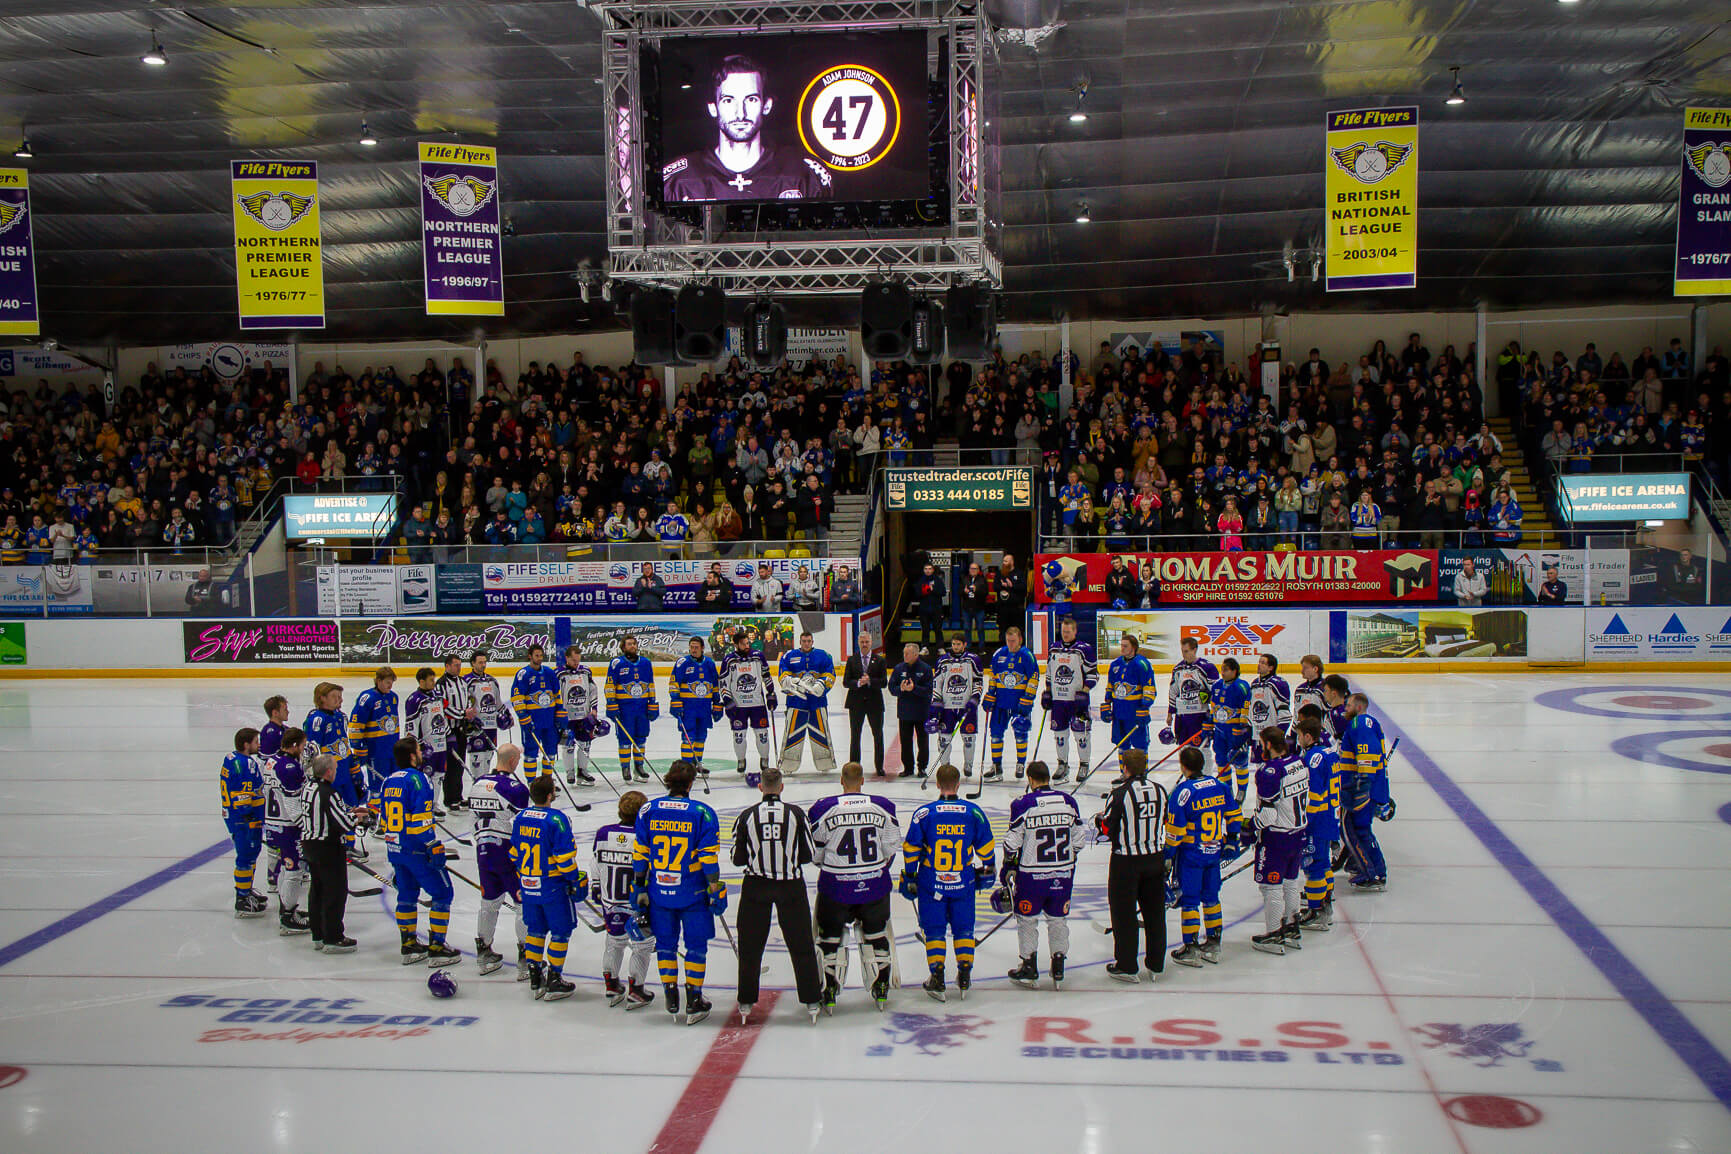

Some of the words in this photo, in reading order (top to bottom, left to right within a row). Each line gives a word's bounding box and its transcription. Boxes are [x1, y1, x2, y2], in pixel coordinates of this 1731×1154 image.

[822, 71, 842, 86] ADAM
[843, 70, 875, 85] JOHNSON
[822, 95, 873, 140] 47
[1334, 113, 1362, 126] Fife
[1363, 111, 1410, 126] Flyers
[1690, 111, 1712, 124] Fife
[427, 146, 452, 158] Fife
[453, 147, 491, 163] Flyers
[830, 154, 847, 166] 1994
[853, 153, 871, 165] 2023
[240, 163, 265, 175] Fife
[266, 163, 311, 178] Flyers
[1337, 189, 1401, 203] BRITISH
[1332, 205, 1411, 220] NATIONAL
[425, 220, 499, 234] NORTHERN
[1340, 222, 1402, 236] LEAGUE
[238, 237, 319, 248] NORTHERN
[433, 236, 493, 249] PREMIER
[246, 252, 312, 263] PREMIER
[437, 252, 491, 264] LEAGUE
[1343, 248, 1397, 260] 2003/04
[250, 267, 310, 278] LEAGUE
[441, 276, 488, 287] 1996/97
[255, 290, 307, 301] 1976/77
[177, 351, 202, 359] CHIPS
[262, 350, 290, 358] PIZZAS
[105, 382, 113, 401] G
[888, 469, 1030, 482] trustedtrader.scot/Fife
[913, 490, 944, 501] 0333
[947, 489, 970, 500] 444
[973, 489, 1004, 500] 0185
[1579, 486, 1607, 497] FIFE
[1612, 486, 1633, 497] ICE
[1637, 484, 1686, 496] ARENA
[314, 497, 358, 509] ADVERTISE
[305, 513, 329, 523] FIFE
[332, 512, 352, 523] ICE
[408, 568, 423, 577] Fife
[507, 564, 538, 575] FIFE
[539, 563, 574, 575] SELF
[664, 562, 700, 573] SELF
[1111, 554, 1258, 583] THOMAS
[1265, 552, 1358, 582] MUIR
[1598, 562, 1626, 570] Trader
[664, 574, 700, 582] DRIVE
[1172, 583, 1223, 591] KIRKCALDY
[1225, 583, 1250, 591] 01592
[1286, 583, 1323, 591] ROSYTH
[1325, 582, 1350, 591] 01383
[1351, 581, 1381, 590] 420000
[485, 594, 508, 602] Tel:
[511, 592, 593, 602] 01592772410
[609, 591, 632, 601] Tel:
[1183, 592, 1203, 601] SKIP
[1205, 592, 1226, 600] HIRE
[1228, 592, 1252, 600] 01592
[1254, 592, 1284, 600] 651076
[266, 624, 337, 635] KIRKCALDY
[1180, 624, 1286, 645] BAY
[190, 624, 264, 662] Styx
[267, 635, 273, 643] &
[276, 635, 336, 643] GLENROTHES
[367, 623, 486, 657] Pettycur
[485, 624, 549, 650] Bay
[1589, 633, 1643, 643] SHEPHERD
[1648, 633, 1700, 643] Hardies
[1204, 647, 1262, 656] HOTEL
[946, 686, 967, 694] CLAN
[1357, 744, 1369, 753] 50
[1140, 802, 1155, 817] 20
[519, 825, 541, 838] HUMITZ
[650, 820, 693, 833] DESROCHER
[763, 824, 781, 840] 88
[936, 824, 966, 835] SPENCE
[1201, 809, 1223, 842] 91
[837, 827, 877, 864] 46
[1035, 827, 1070, 862] 22
[520, 842, 542, 876] 21
[652, 835, 688, 871] 37
[934, 839, 963, 872] 61
[160, 994, 365, 1010] Scott
[217, 1009, 481, 1026] Gibson
[196, 1024, 432, 1044] Bodyshop
[1021, 1015, 1392, 1050] R.S.S.
[1020, 1045, 1290, 1064] SECURITIES
[1316, 1051, 1405, 1066] LTD
